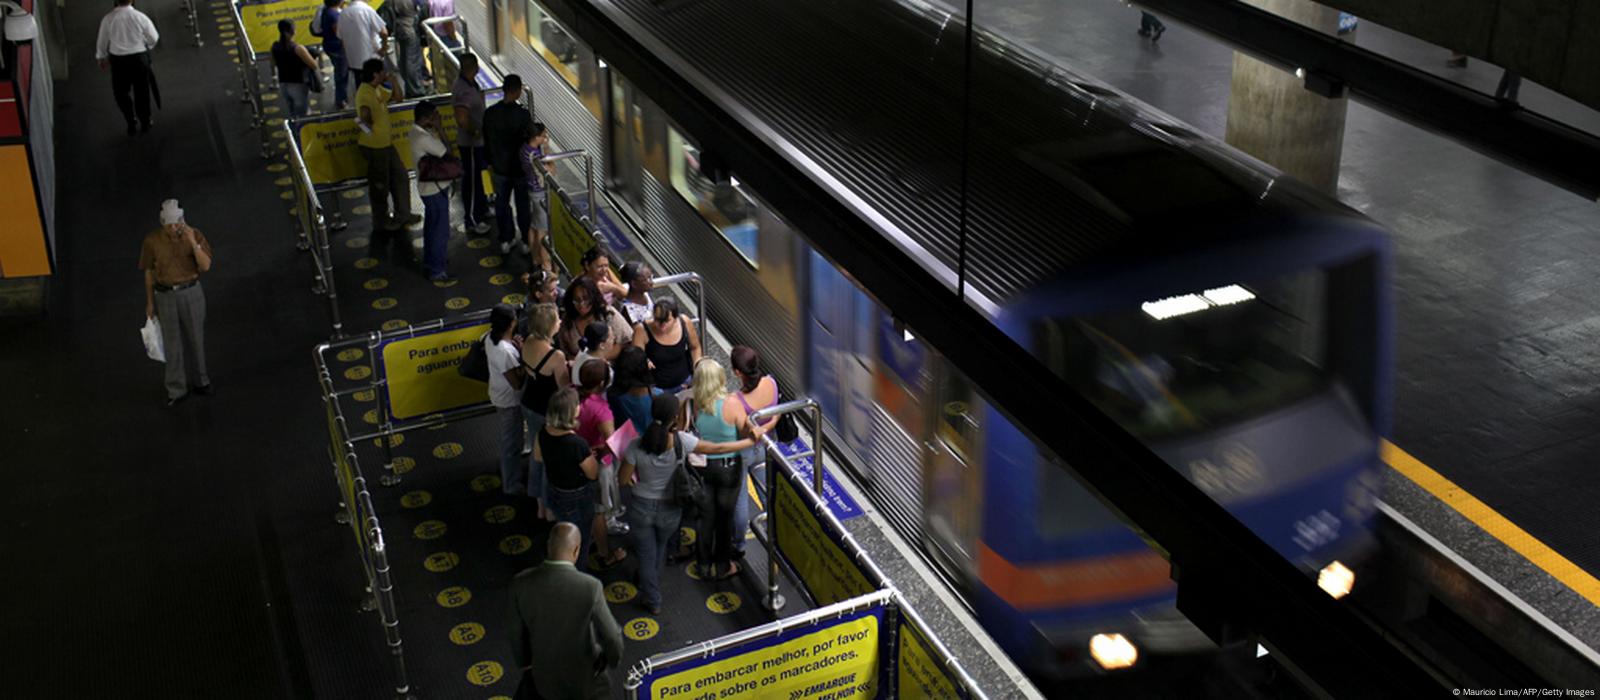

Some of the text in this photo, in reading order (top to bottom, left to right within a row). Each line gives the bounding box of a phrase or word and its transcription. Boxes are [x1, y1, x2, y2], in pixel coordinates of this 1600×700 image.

[408, 340, 472, 360] Para emb
[417, 356, 462, 374] aguard
[457, 626, 476, 641] A9
[660, 682, 692, 699] Para
[695, 663, 759, 688] embarcar
[762, 647, 810, 669] melhor,
[813, 640, 834, 656] por
[837, 628, 870, 646] favor
[720, 649, 859, 698] sobre os marcadores.
[476, 665, 494, 683] A10
[804, 672, 857, 697] EMBARQUE
